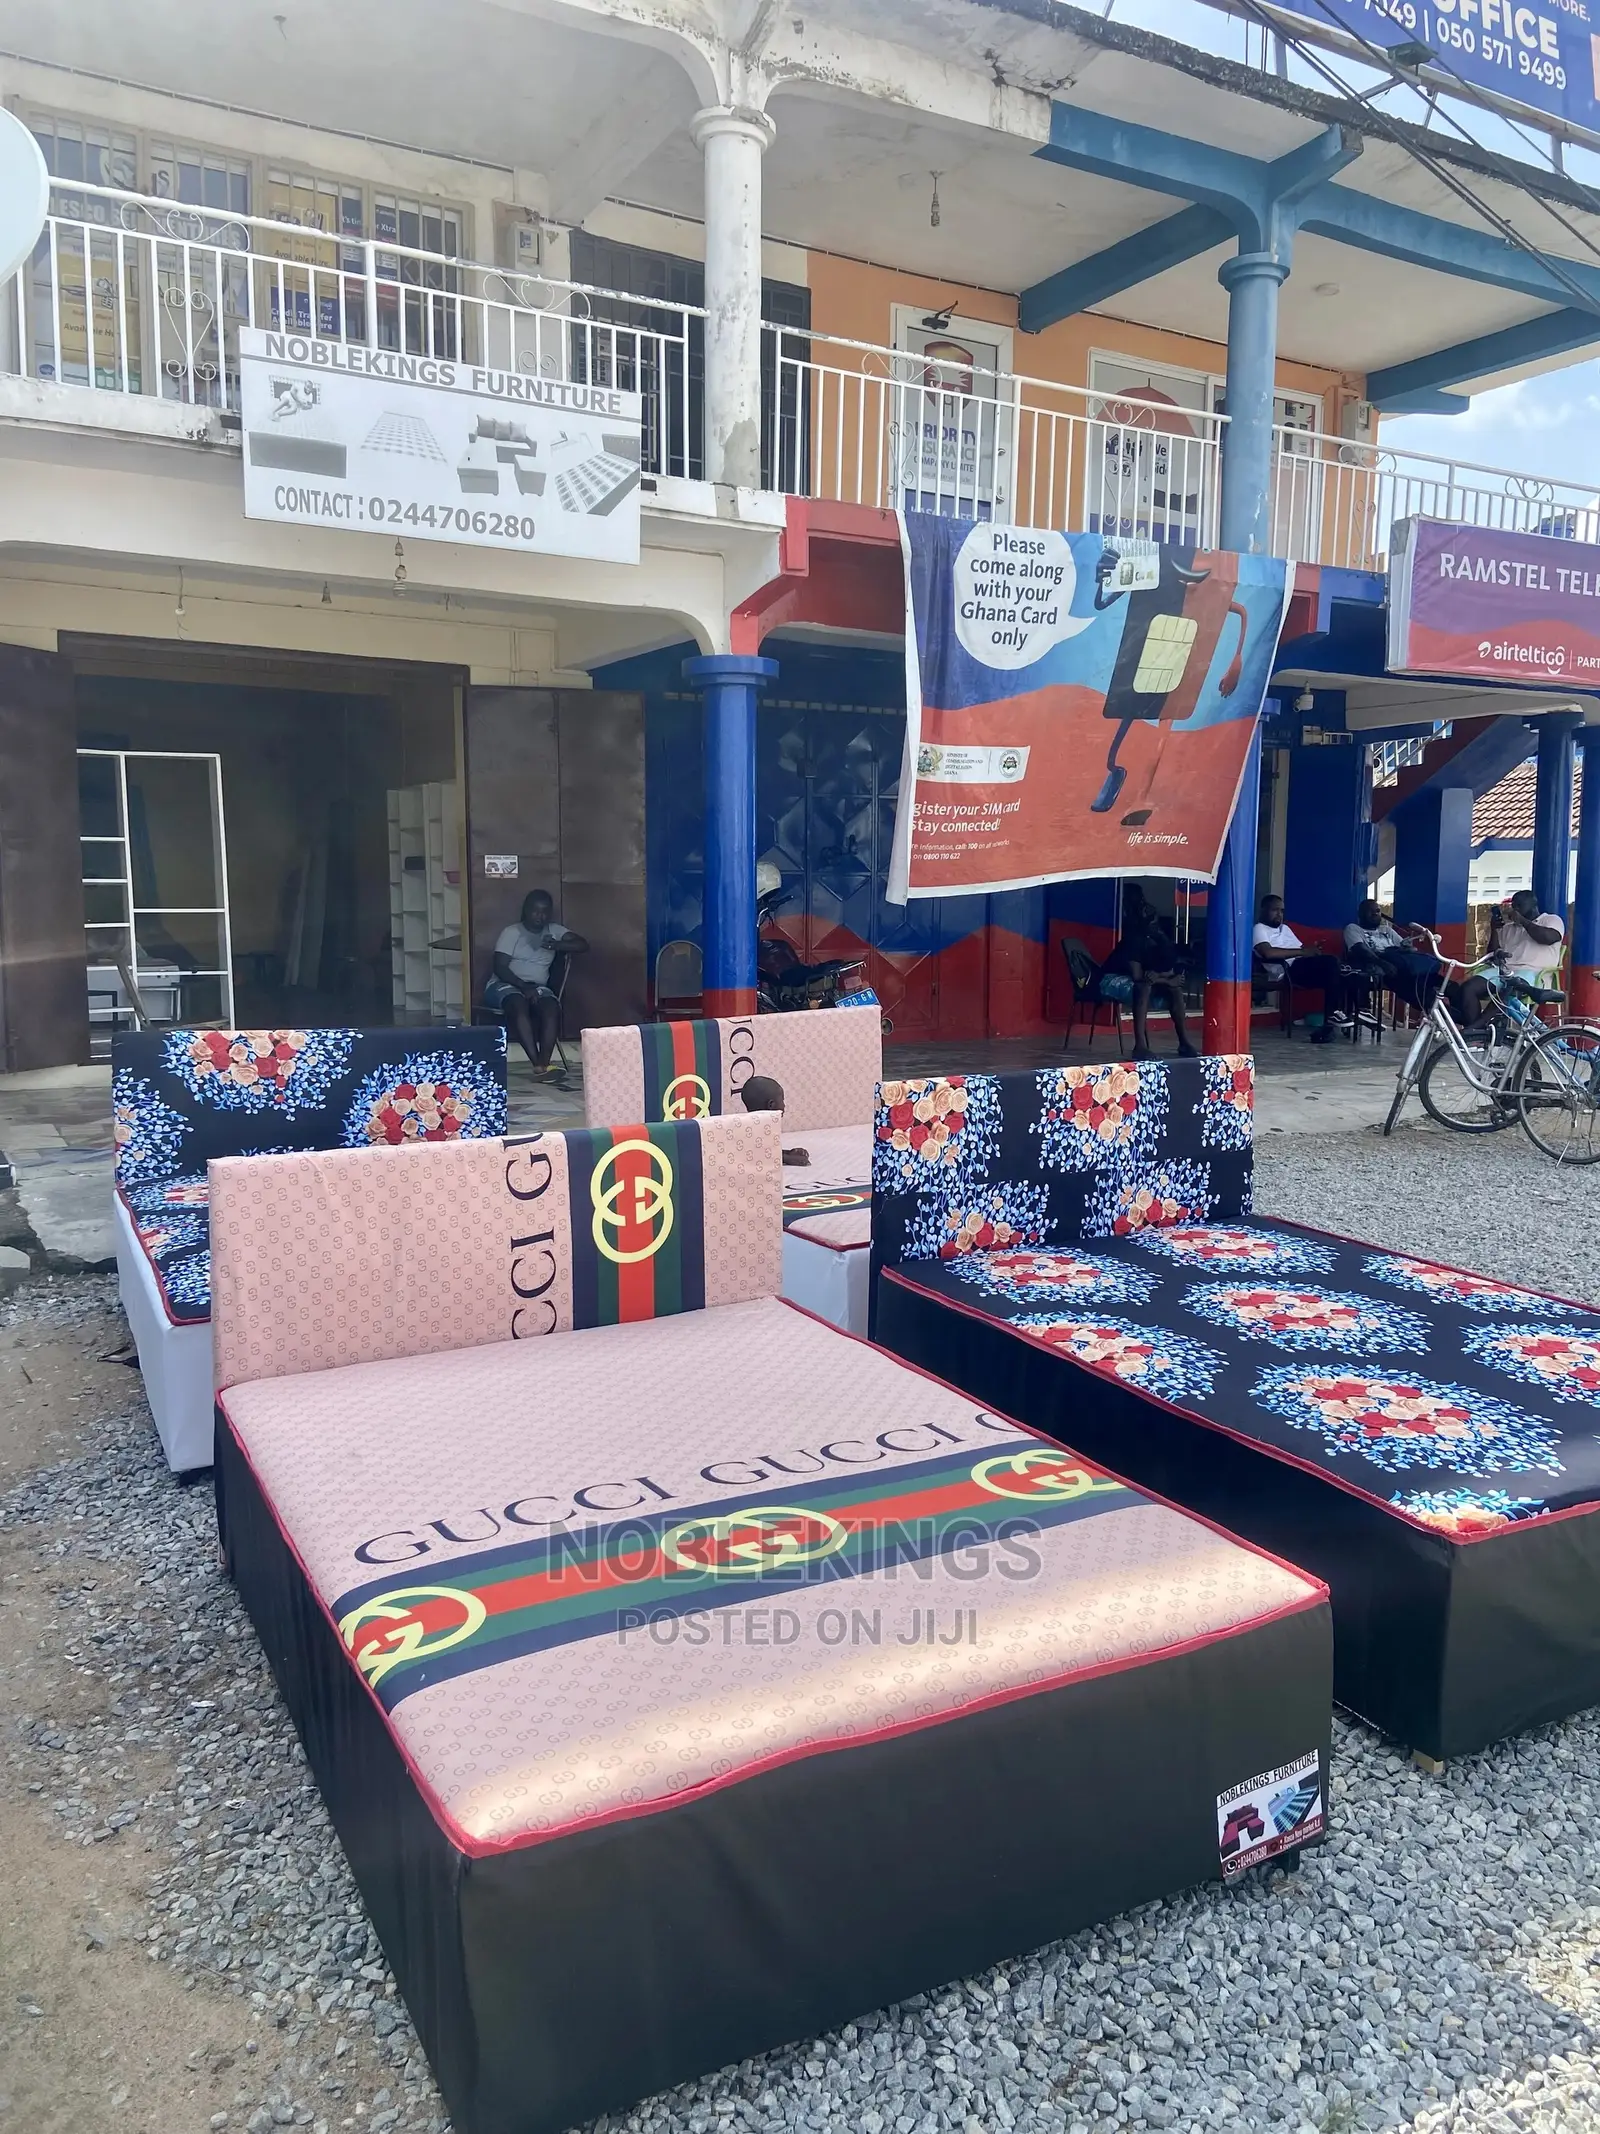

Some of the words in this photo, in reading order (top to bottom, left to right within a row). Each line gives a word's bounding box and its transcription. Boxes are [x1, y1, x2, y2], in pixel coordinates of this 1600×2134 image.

[1436, 17, 1475, 53] 050
[1482, 35, 1514, 69] 571
[1518, 51, 1567, 90] 9499
[265, 333, 456, 386] NOBLEKINGS
[473, 369, 621, 415] FURNITURE
[914, 421, 976, 446] RIORTY
[993, 533, 1045, 555] Please
[970, 558, 1016, 576] come
[1020, 559, 1064, 585] along
[1440, 552, 1551, 591] RAMSTEL
[974, 579, 1011, 599] with
[1015, 588, 1053, 605] your
[961, 601, 1016, 624] Ghana
[1021, 606, 1058, 625] Card
[991, 627, 1028, 651] only
[953, 805, 980, 819] your
[981, 802, 1002, 816] SIM
[1003, 798, 1021, 814] card
[941, 818, 1001, 833] connected!
[967, 842, 978, 850] 100
[1126, 832, 1143, 847] life
[1143, 832, 1152, 844] is
[1154, 832, 1189, 847] simple.
[950, 852, 960, 860] 622
[354, 1475, 679, 1565] GUCCI
[700, 1421, 968, 1485] GUCCI
[1219, 1773, 1270, 1807] NOBLEKINGS
[1273, 1751, 1317, 1782] FURNITURE
